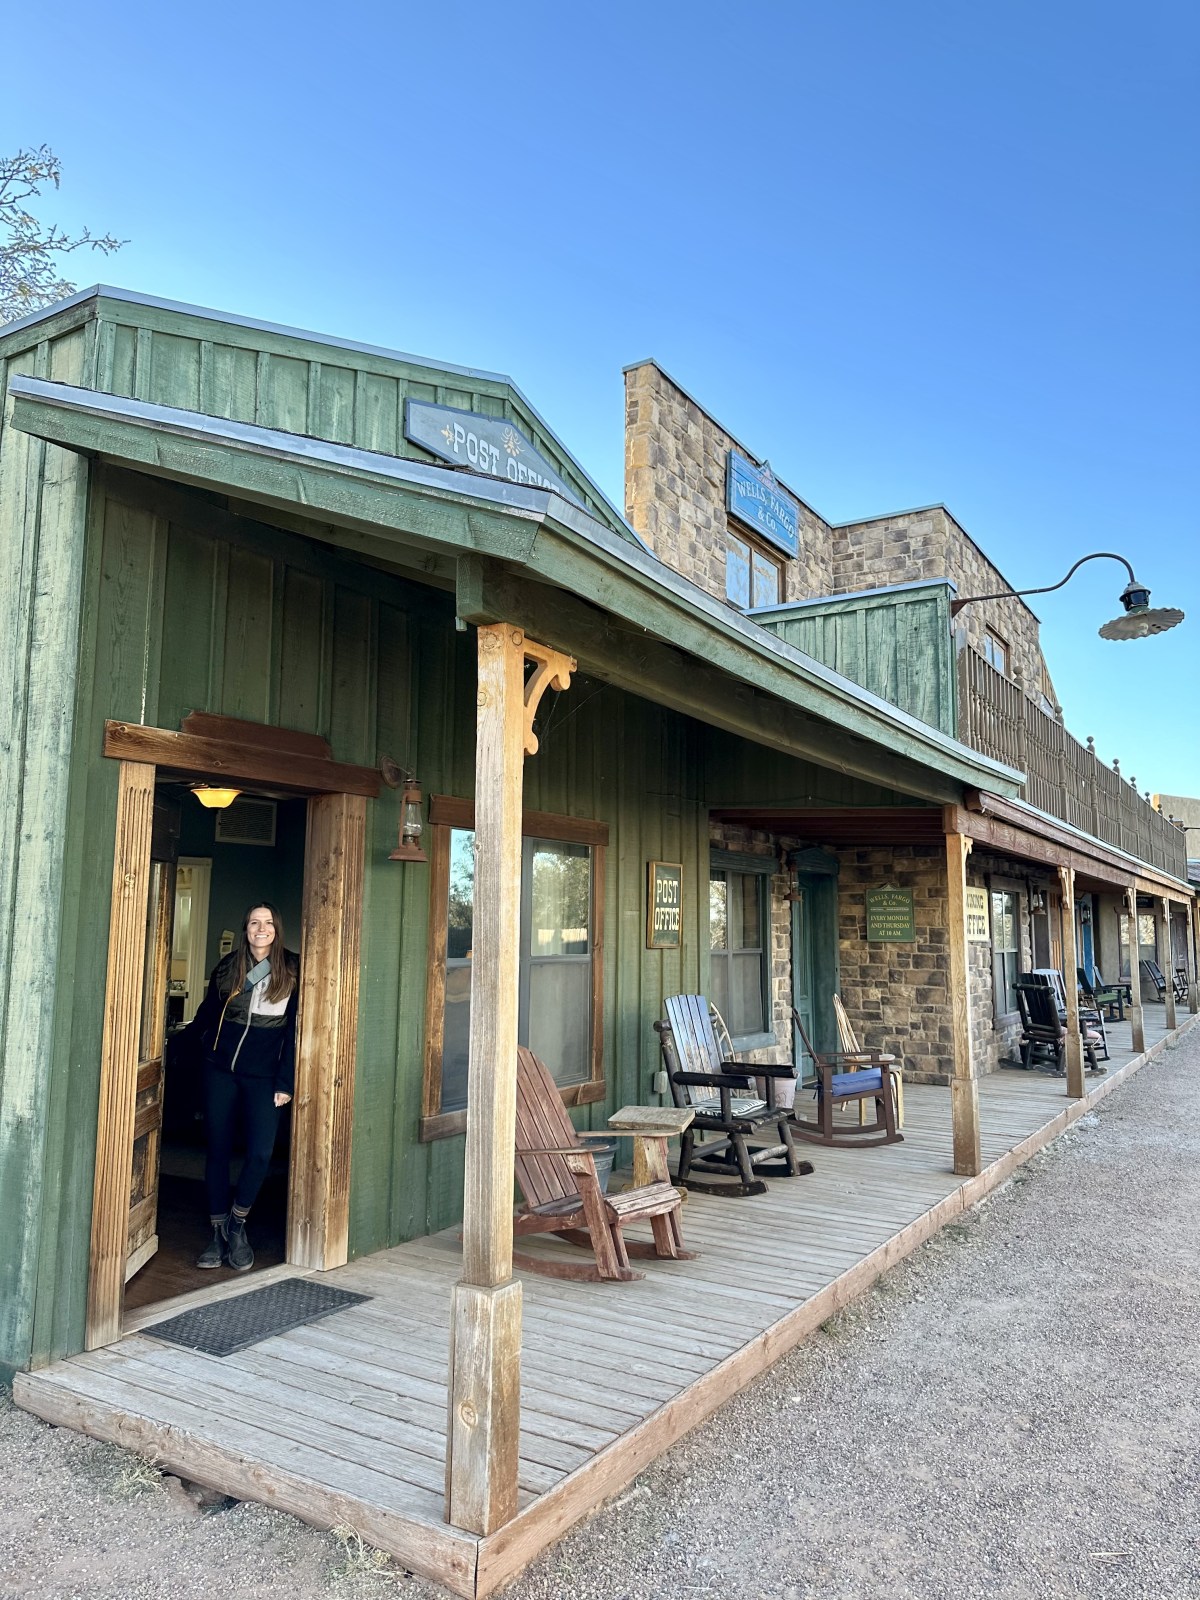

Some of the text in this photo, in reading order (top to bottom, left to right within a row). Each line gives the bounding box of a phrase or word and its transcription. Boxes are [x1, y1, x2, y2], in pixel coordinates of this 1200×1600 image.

[453, 422, 500, 475] POST
[737, 481, 795, 538] WELLS, FARGO
[757, 506, 765, 522] &
[656, 879, 679, 903] POST
[891, 893, 911, 904] FARGO
[654, 907, 680, 931] OFFICE
